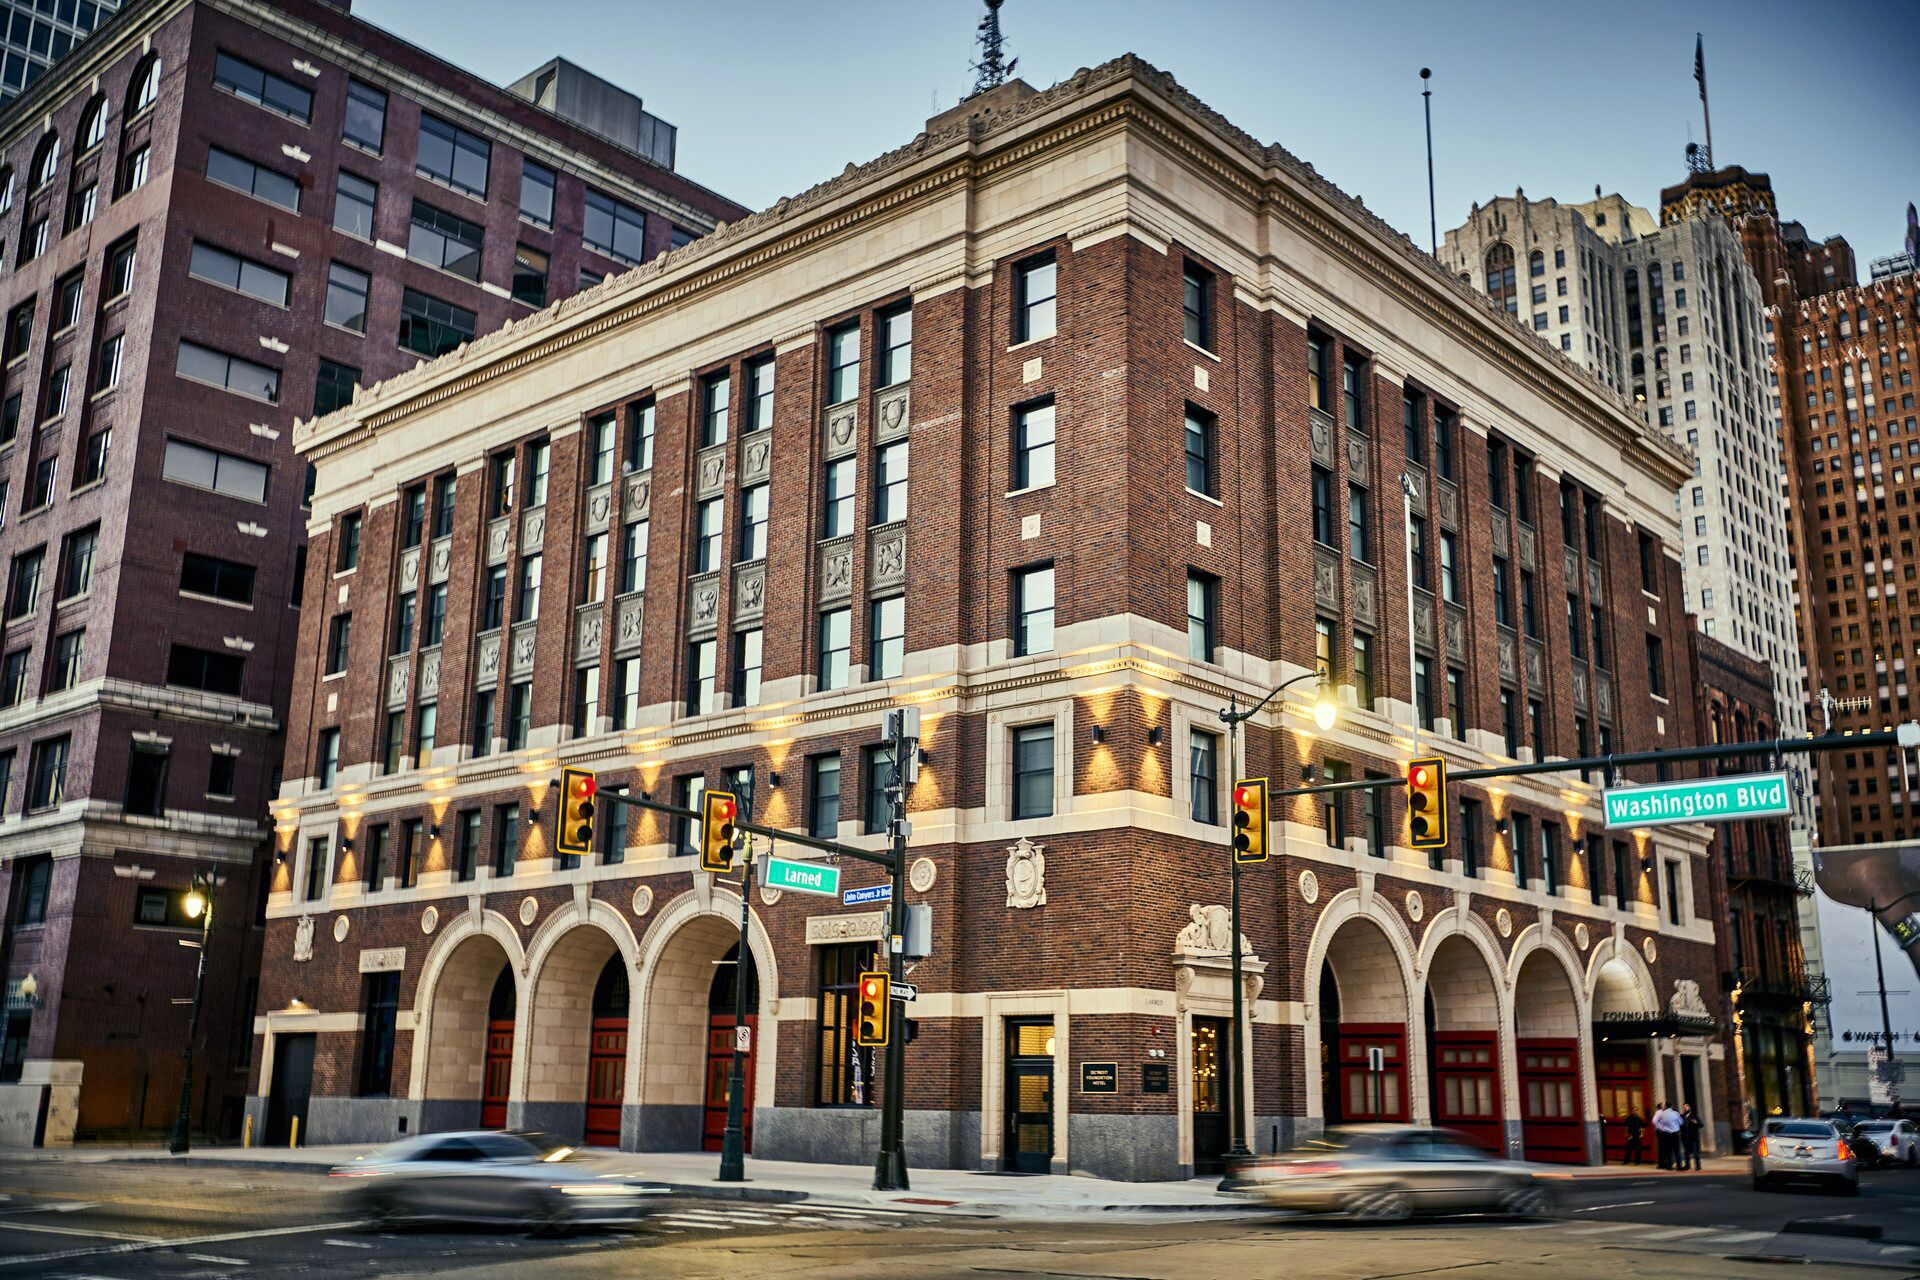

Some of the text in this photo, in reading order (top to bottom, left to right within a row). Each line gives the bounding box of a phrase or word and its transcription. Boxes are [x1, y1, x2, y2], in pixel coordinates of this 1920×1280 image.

[1612, 783, 1781, 817] Washington Blvd
[785, 867, 821, 886] Larned
[845, 892, 857, 902] John
[856, 890, 875, 900] Conyers
[1602, 1010, 1679, 1022] FOUNDATIN
